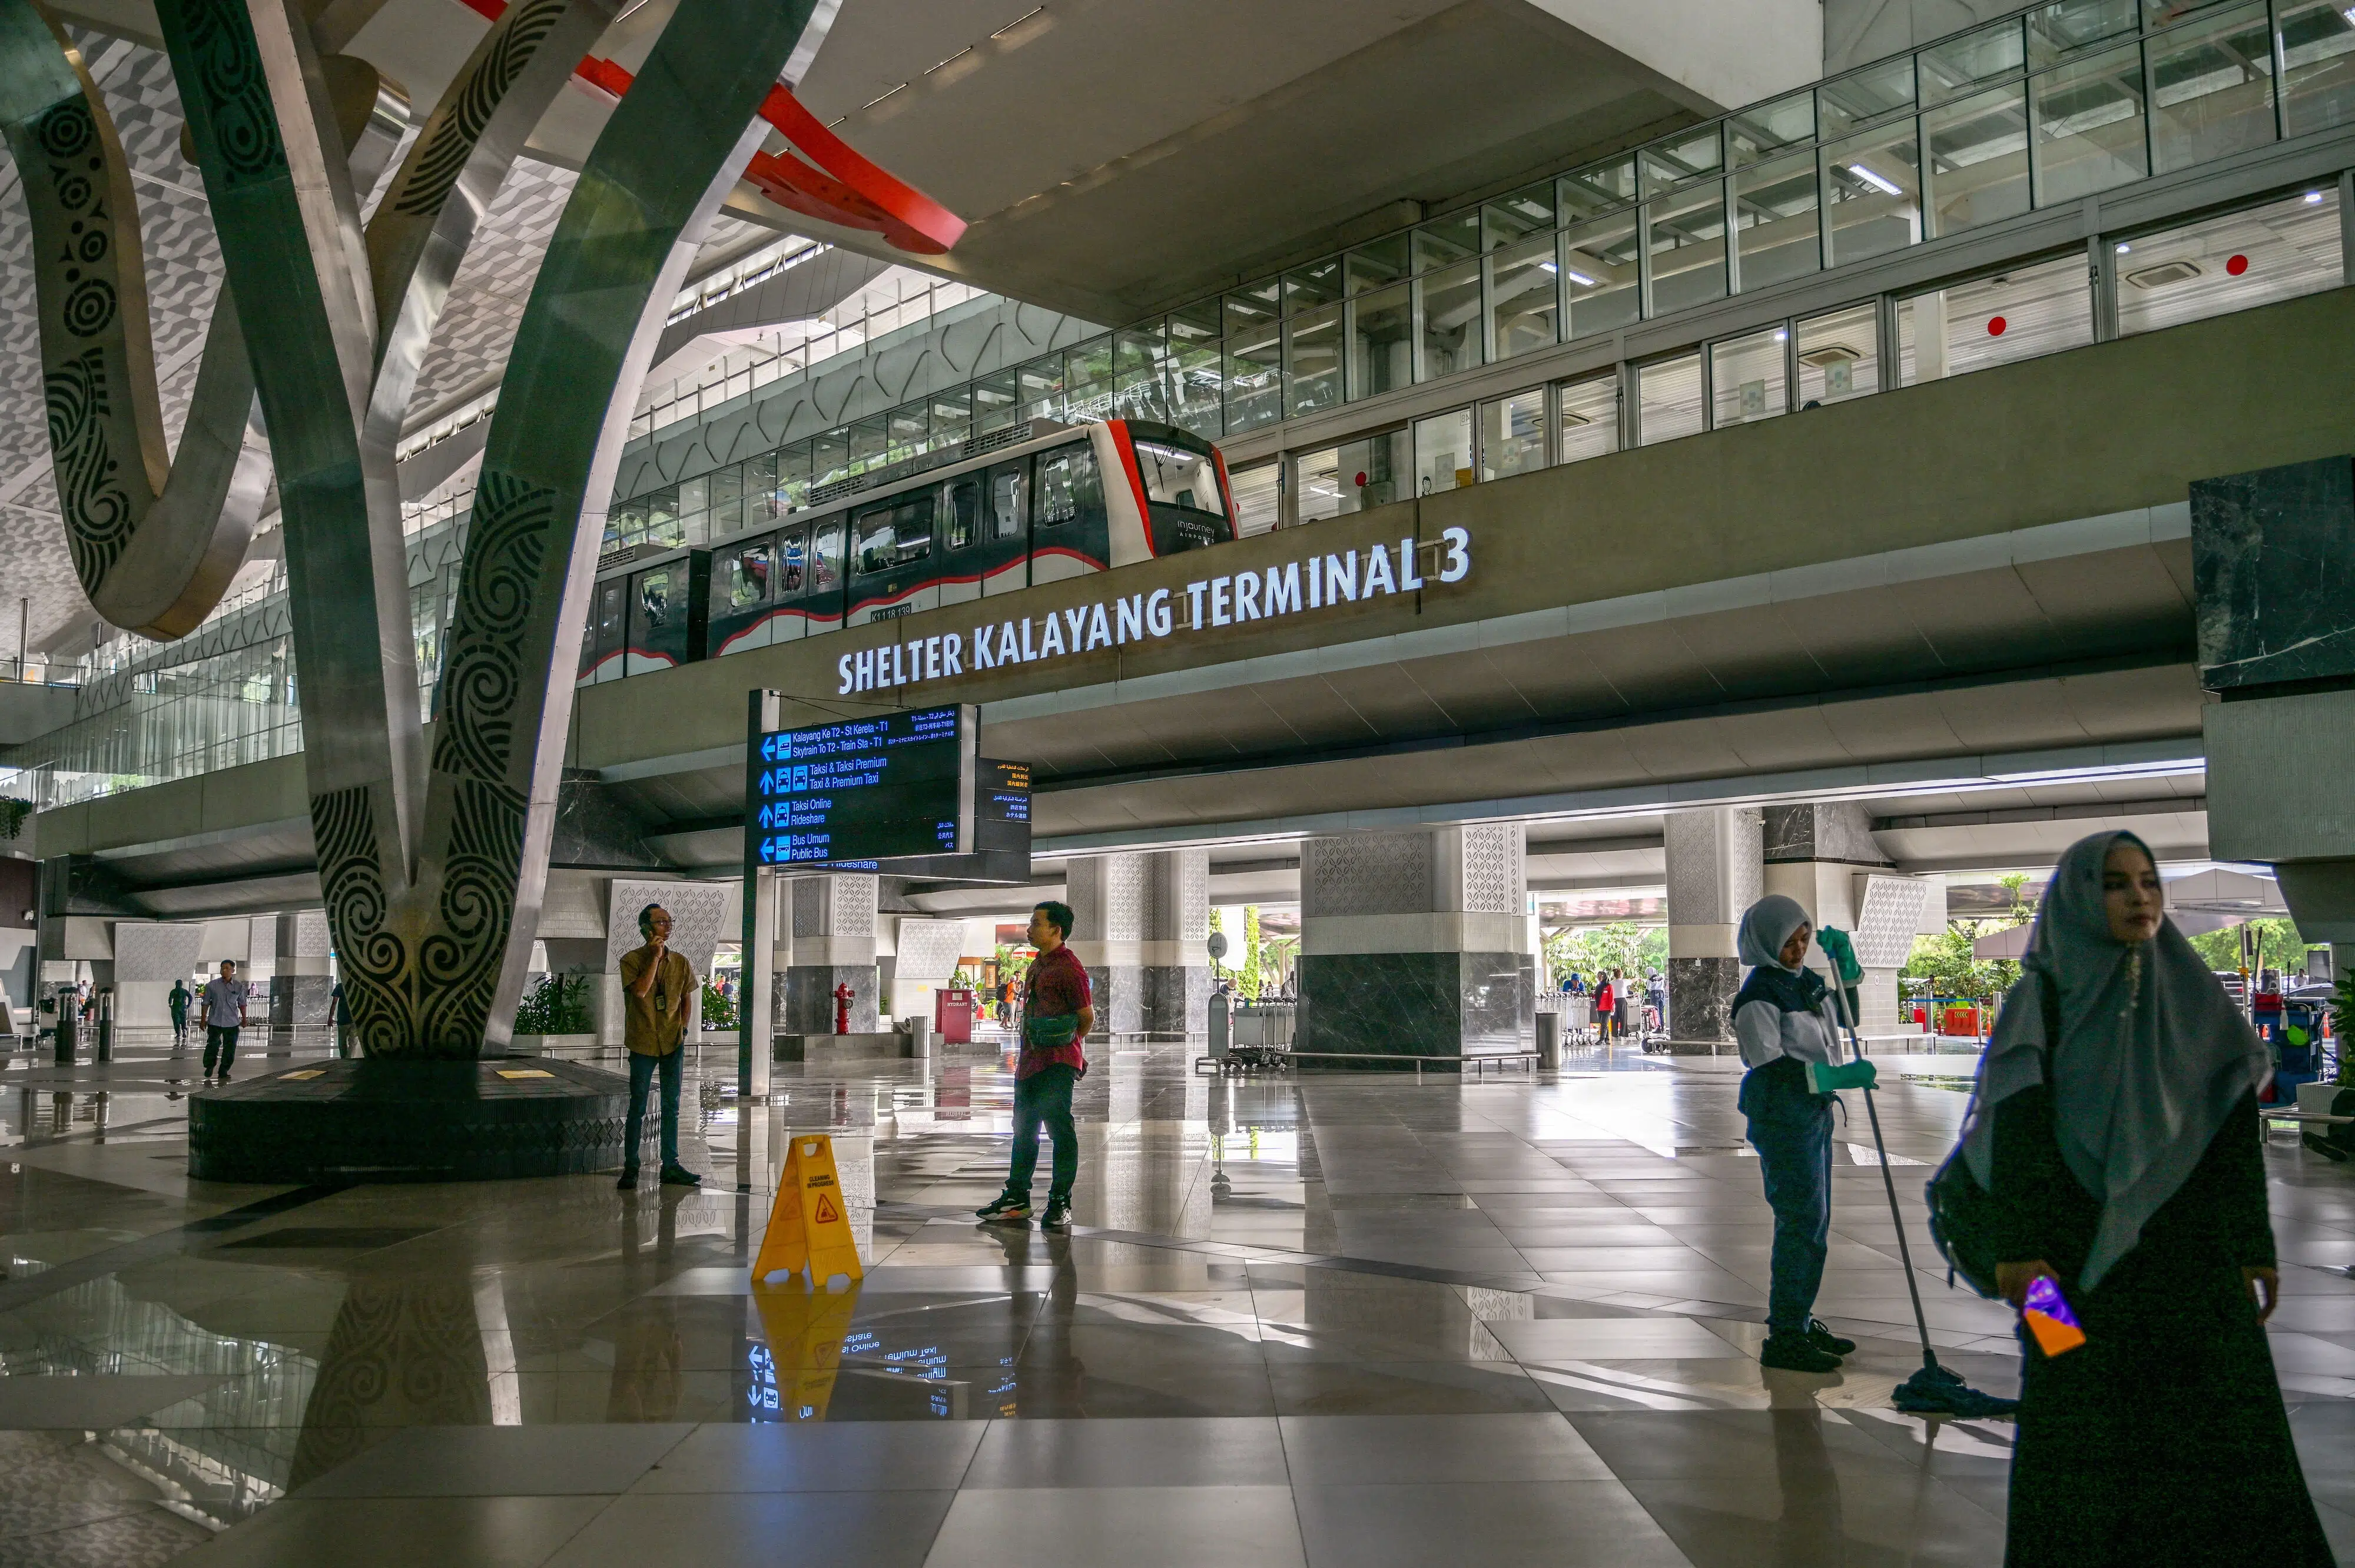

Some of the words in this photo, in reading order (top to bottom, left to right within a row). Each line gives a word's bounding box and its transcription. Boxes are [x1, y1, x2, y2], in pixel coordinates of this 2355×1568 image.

[1180, 532, 1215, 543] AIRPORTS
[838, 633, 963, 695] SHELTER
[974, 589, 1171, 670] KALAYANG
[1187, 537, 1424, 630] TERMINAL
[1440, 526, 1471, 583] 3
[793, 731, 821, 743] Kalayang
[822, 729, 831, 739] Ke
[831, 727, 840, 738] T2
[845, 725, 853, 736] St
[854, 723, 874, 735] Kereta
[880, 721, 888, 731] T1
[793, 745, 817, 758] Skytrain
[818, 743, 826, 753] To
[827, 743, 835, 752] T2
[840, 740, 855, 751] Train
[857, 738, 868, 749] Sta
[873, 737, 882, 747] T1
[810, 763, 827, 775] Taksi
[829, 762, 835, 773] &
[836, 760, 854, 772] Taksi
[855, 756, 887, 770] Premium
[810, 778, 823, 789] Taxi
[825, 777, 831, 788] &
[832, 775, 863, 788] Premium
[864, 772, 878, 784] Taxi
[792, 800, 808, 812] Taksi
[810, 798, 831, 810] Online
[791, 813, 825, 826] Rideshare
[792, 835, 805, 845] Bus
[807, 833, 830, 844] Umum
[792, 848, 812, 860] Public
[814, 847, 828, 858] Bus
